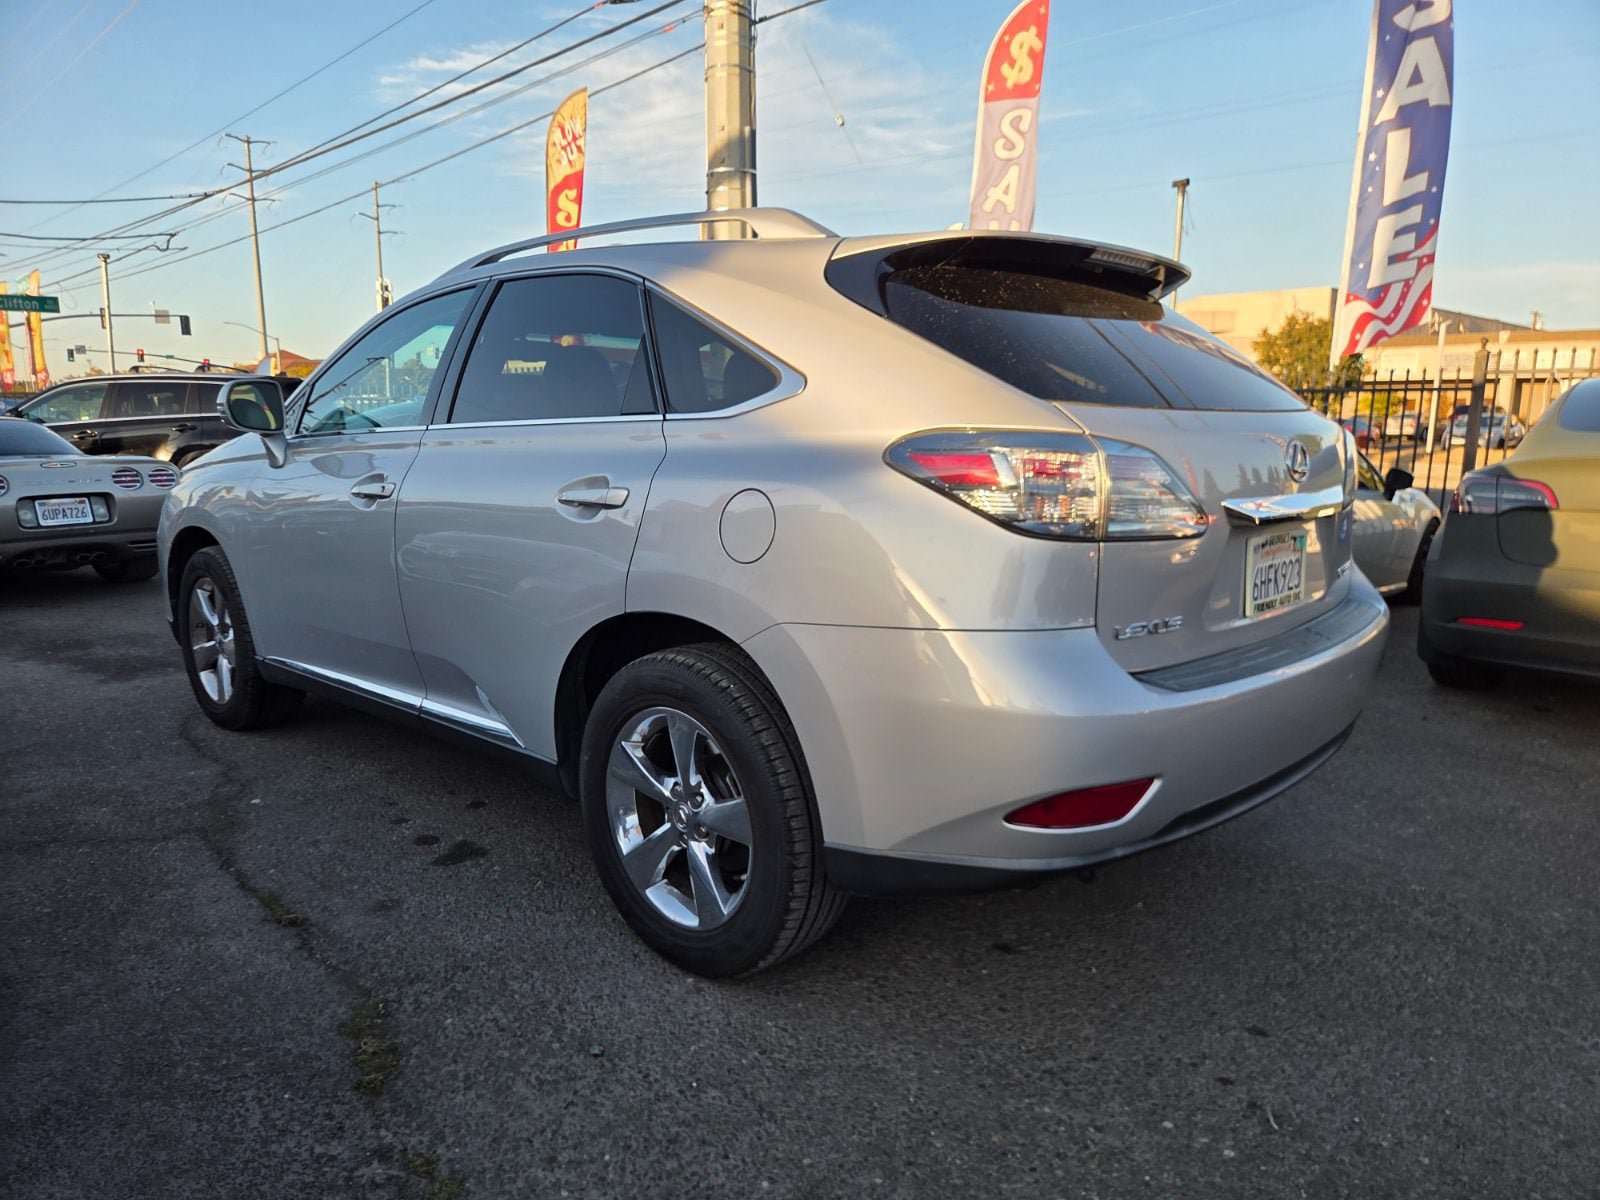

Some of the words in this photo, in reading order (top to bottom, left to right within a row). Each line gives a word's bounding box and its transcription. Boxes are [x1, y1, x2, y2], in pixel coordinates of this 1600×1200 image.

[982, 107, 1033, 231] SA
[42, 506, 87, 520] 6UPA726
[1252, 558, 1300, 602] 6HFK923
[1112, 615, 1184, 641] LEXUS
